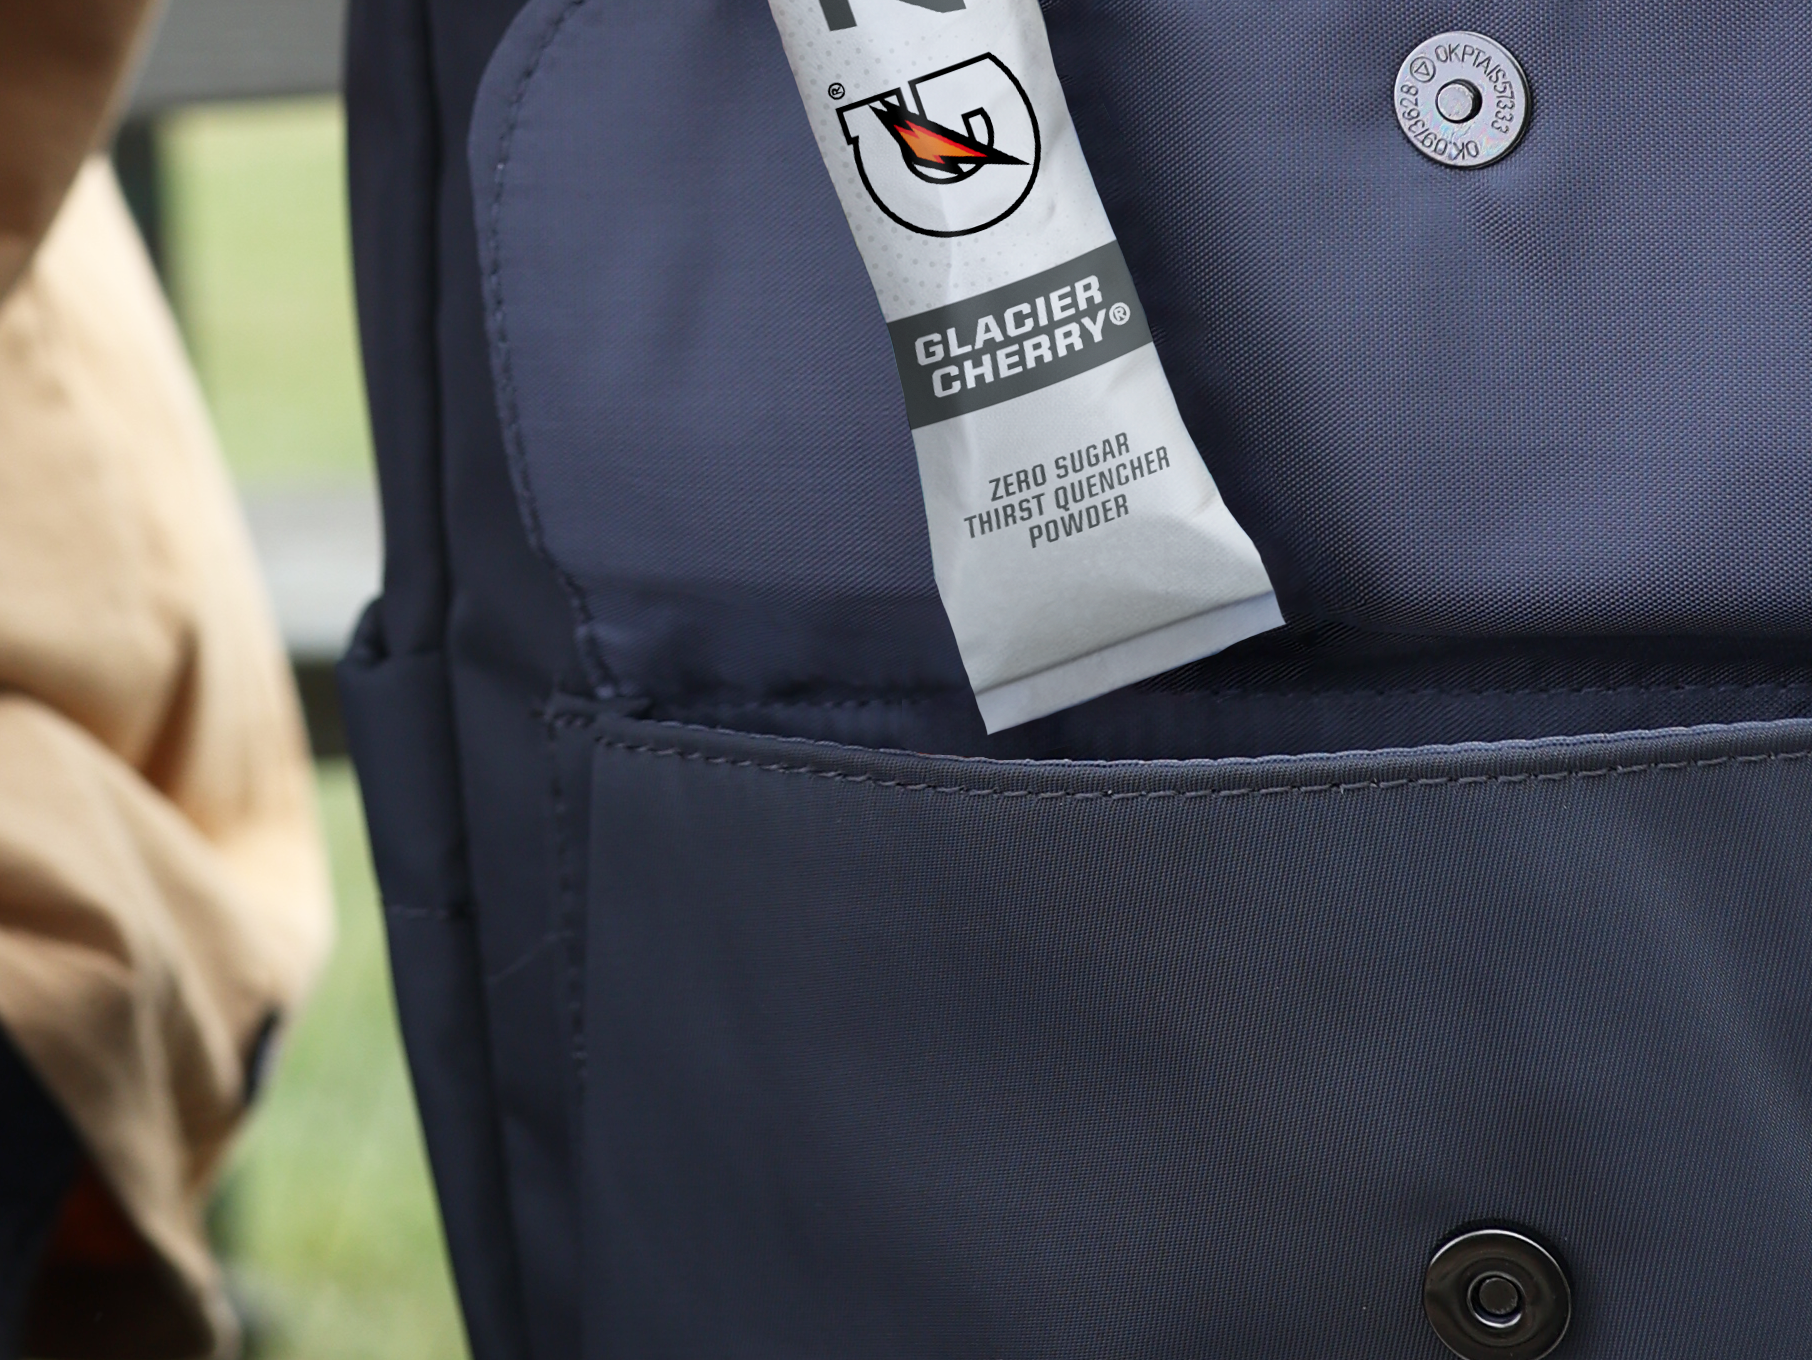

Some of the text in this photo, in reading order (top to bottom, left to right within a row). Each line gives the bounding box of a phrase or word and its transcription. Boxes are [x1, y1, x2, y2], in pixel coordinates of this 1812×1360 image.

[915, 275, 1103, 366] GLACIER
[964, 446, 1170, 538] THIRST QUENCHER
[989, 432, 1130, 502] ZERO SUGAR
[1029, 493, 1129, 548] POWDER
